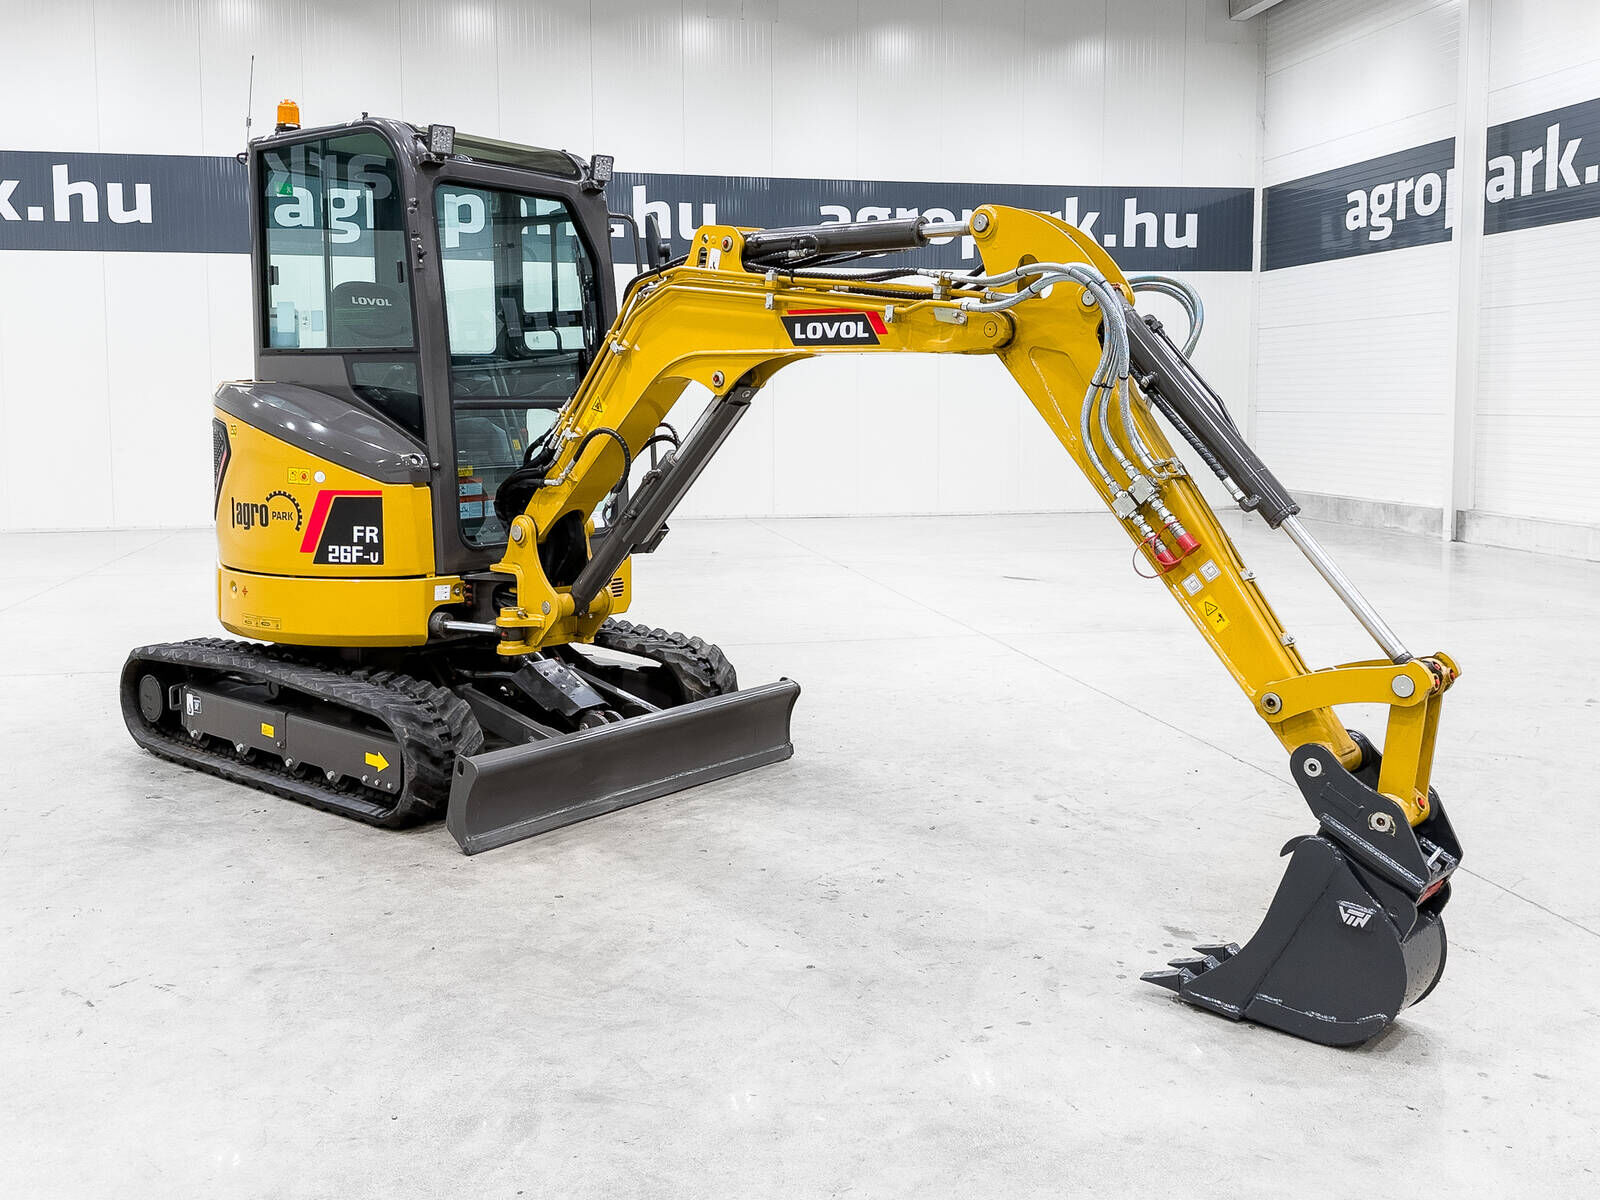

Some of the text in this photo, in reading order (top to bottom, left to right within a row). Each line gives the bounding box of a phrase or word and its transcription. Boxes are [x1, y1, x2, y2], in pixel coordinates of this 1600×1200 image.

[351, 296, 392, 307] LOVOL
[794, 321, 869, 339] LOVOL
[236, 501, 294, 531] agro PARK
[352, 525, 379, 544] FR
